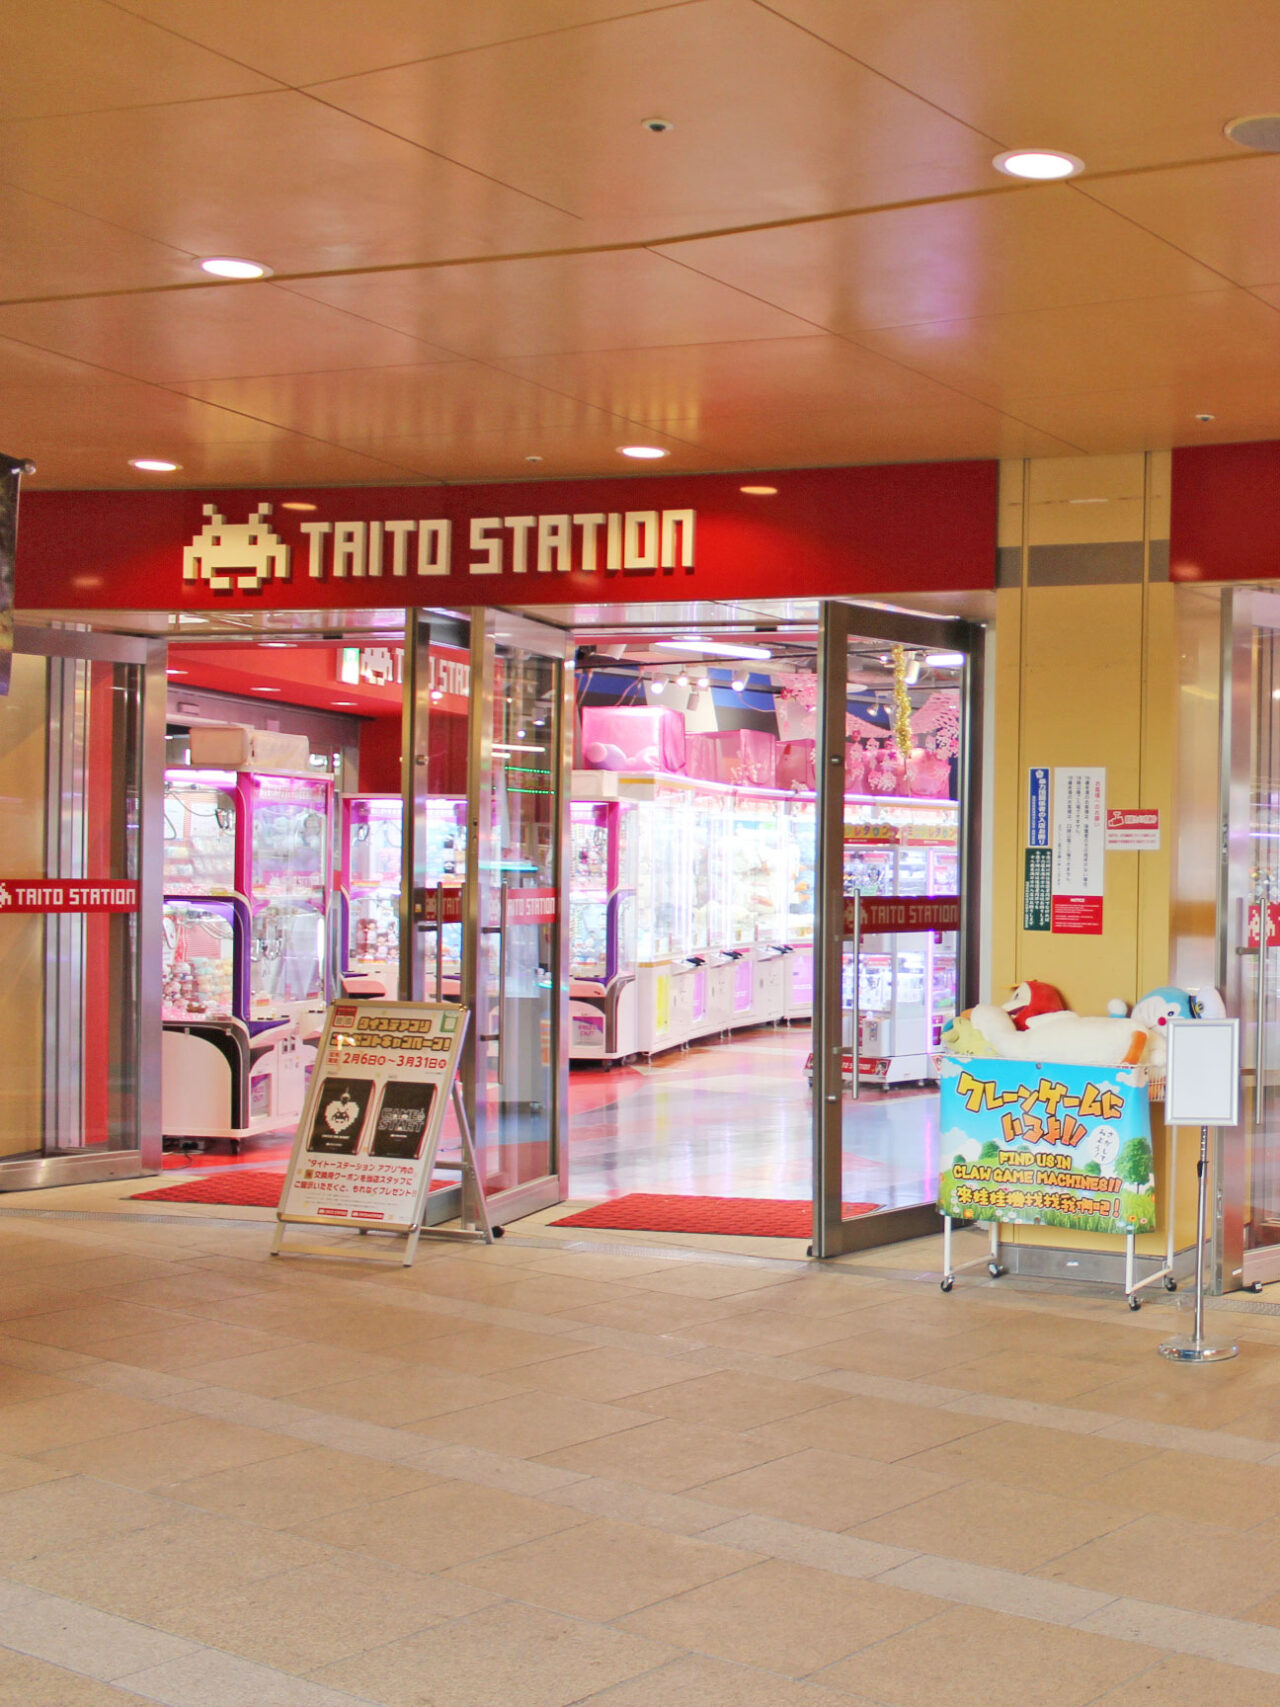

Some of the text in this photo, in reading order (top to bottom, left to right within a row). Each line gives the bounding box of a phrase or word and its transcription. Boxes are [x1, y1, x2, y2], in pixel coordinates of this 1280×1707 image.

[300, 509, 695, 578] TAITO STATION
[15, 888, 136, 905] TAITO STATION
[870, 904, 958, 925] TAITO STATION
[956, 1071, 1125, 1120] クレーンゲームに
[998, 1150, 1072, 1171] FIND US IN
[952, 1164, 1123, 1194] CLAW GAME MACHINES!!
